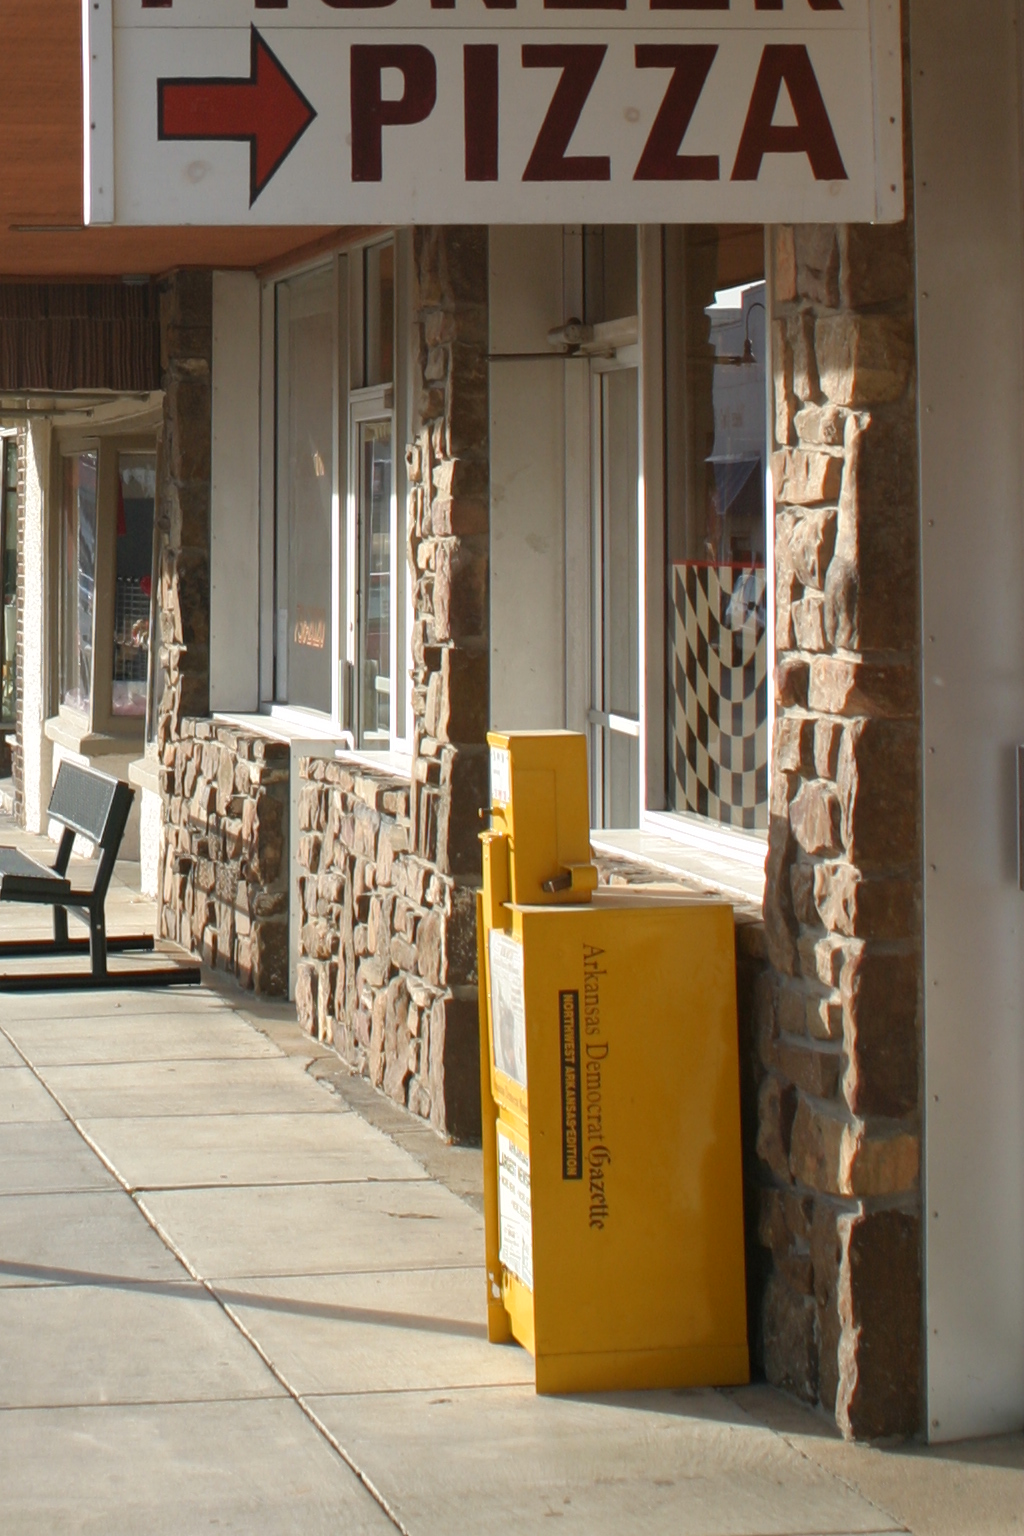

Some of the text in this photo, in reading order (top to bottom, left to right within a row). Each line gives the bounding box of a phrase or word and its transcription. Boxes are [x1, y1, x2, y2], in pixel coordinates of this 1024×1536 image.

[349, 43, 850, 183] PIZZA
[562, 993, 578, 1177] NORTHWEST ARKANSAS EDITION
[582, 942, 611, 1231] Arkansas Democrat Gazette
